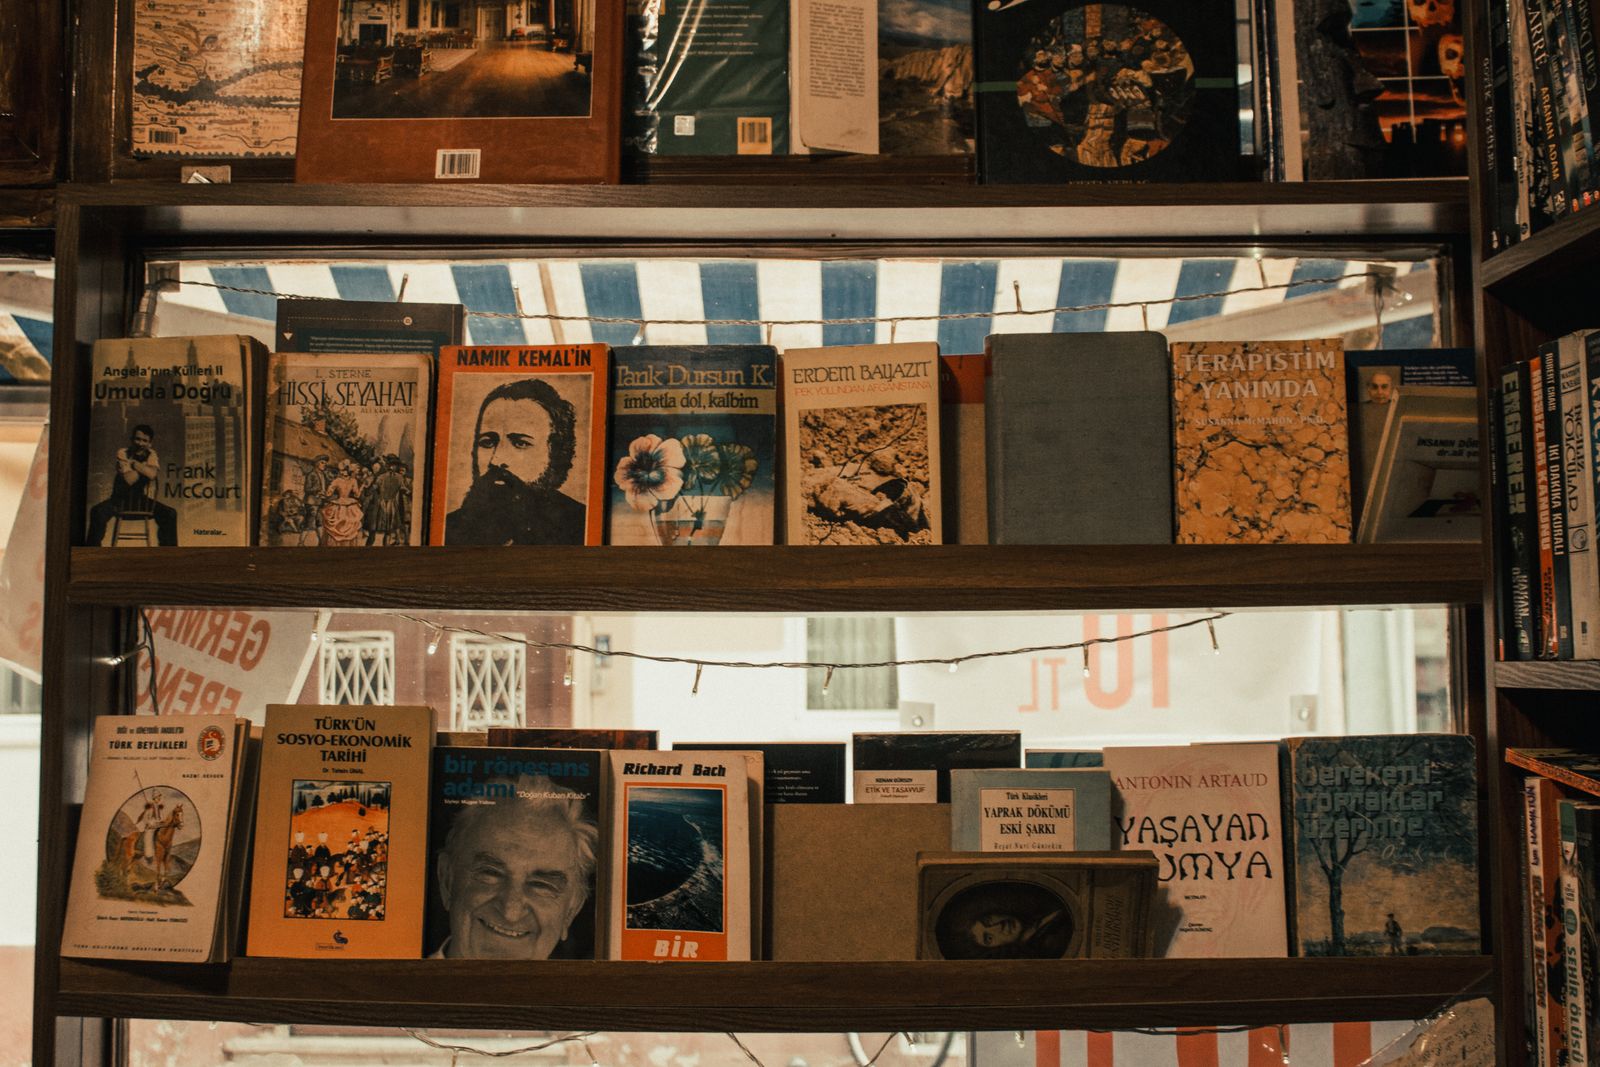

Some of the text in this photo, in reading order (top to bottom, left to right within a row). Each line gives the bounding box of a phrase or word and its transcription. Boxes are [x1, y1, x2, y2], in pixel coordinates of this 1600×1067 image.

[1527, 0, 1549, 69] ARRÉ
[1540, 86, 1560, 181] ARANAN ADAM
[457, 349, 510, 367] NAMIK
[1180, 346, 1336, 373] TERAPİSTİM
[172, 364, 212, 377] Külleri
[329, 369, 372, 379] STERNE
[667, 364, 744, 386] Dursun
[792, 365, 855, 384] ERDEM
[95, 382, 231, 404] Umuda Doğru
[335, 380, 417, 407] SEYAHAT
[1200, 378, 1319, 401] YANIMDA
[1502, 371, 1526, 514] ENGEREK
[167, 462, 216, 479] Frank
[164, 482, 241, 499] McCourt
[314, 716, 376, 731] TÜRK'ÜN
[109, 739, 188, 750] TÜRK BEYLİKLERİ
[277, 733, 412, 748] SOSYO-EKONOMİK
[320, 748, 367, 762] TARİHİ
[444, 754, 590, 777] bir rönesans
[623, 762, 726, 778] Richard Bach
[1115, 773, 1268, 790] ANTONIN ARTAUD
[984, 804, 1070, 818] YAPRAK DÖKÜMÜ
[1000, 821, 1056, 837] ESKİ ŞARKI
[1113, 813, 1270, 848] YAŞAYAN
[1158, 851, 1273, 881] UMYA
[654, 935, 700, 959] BİR
